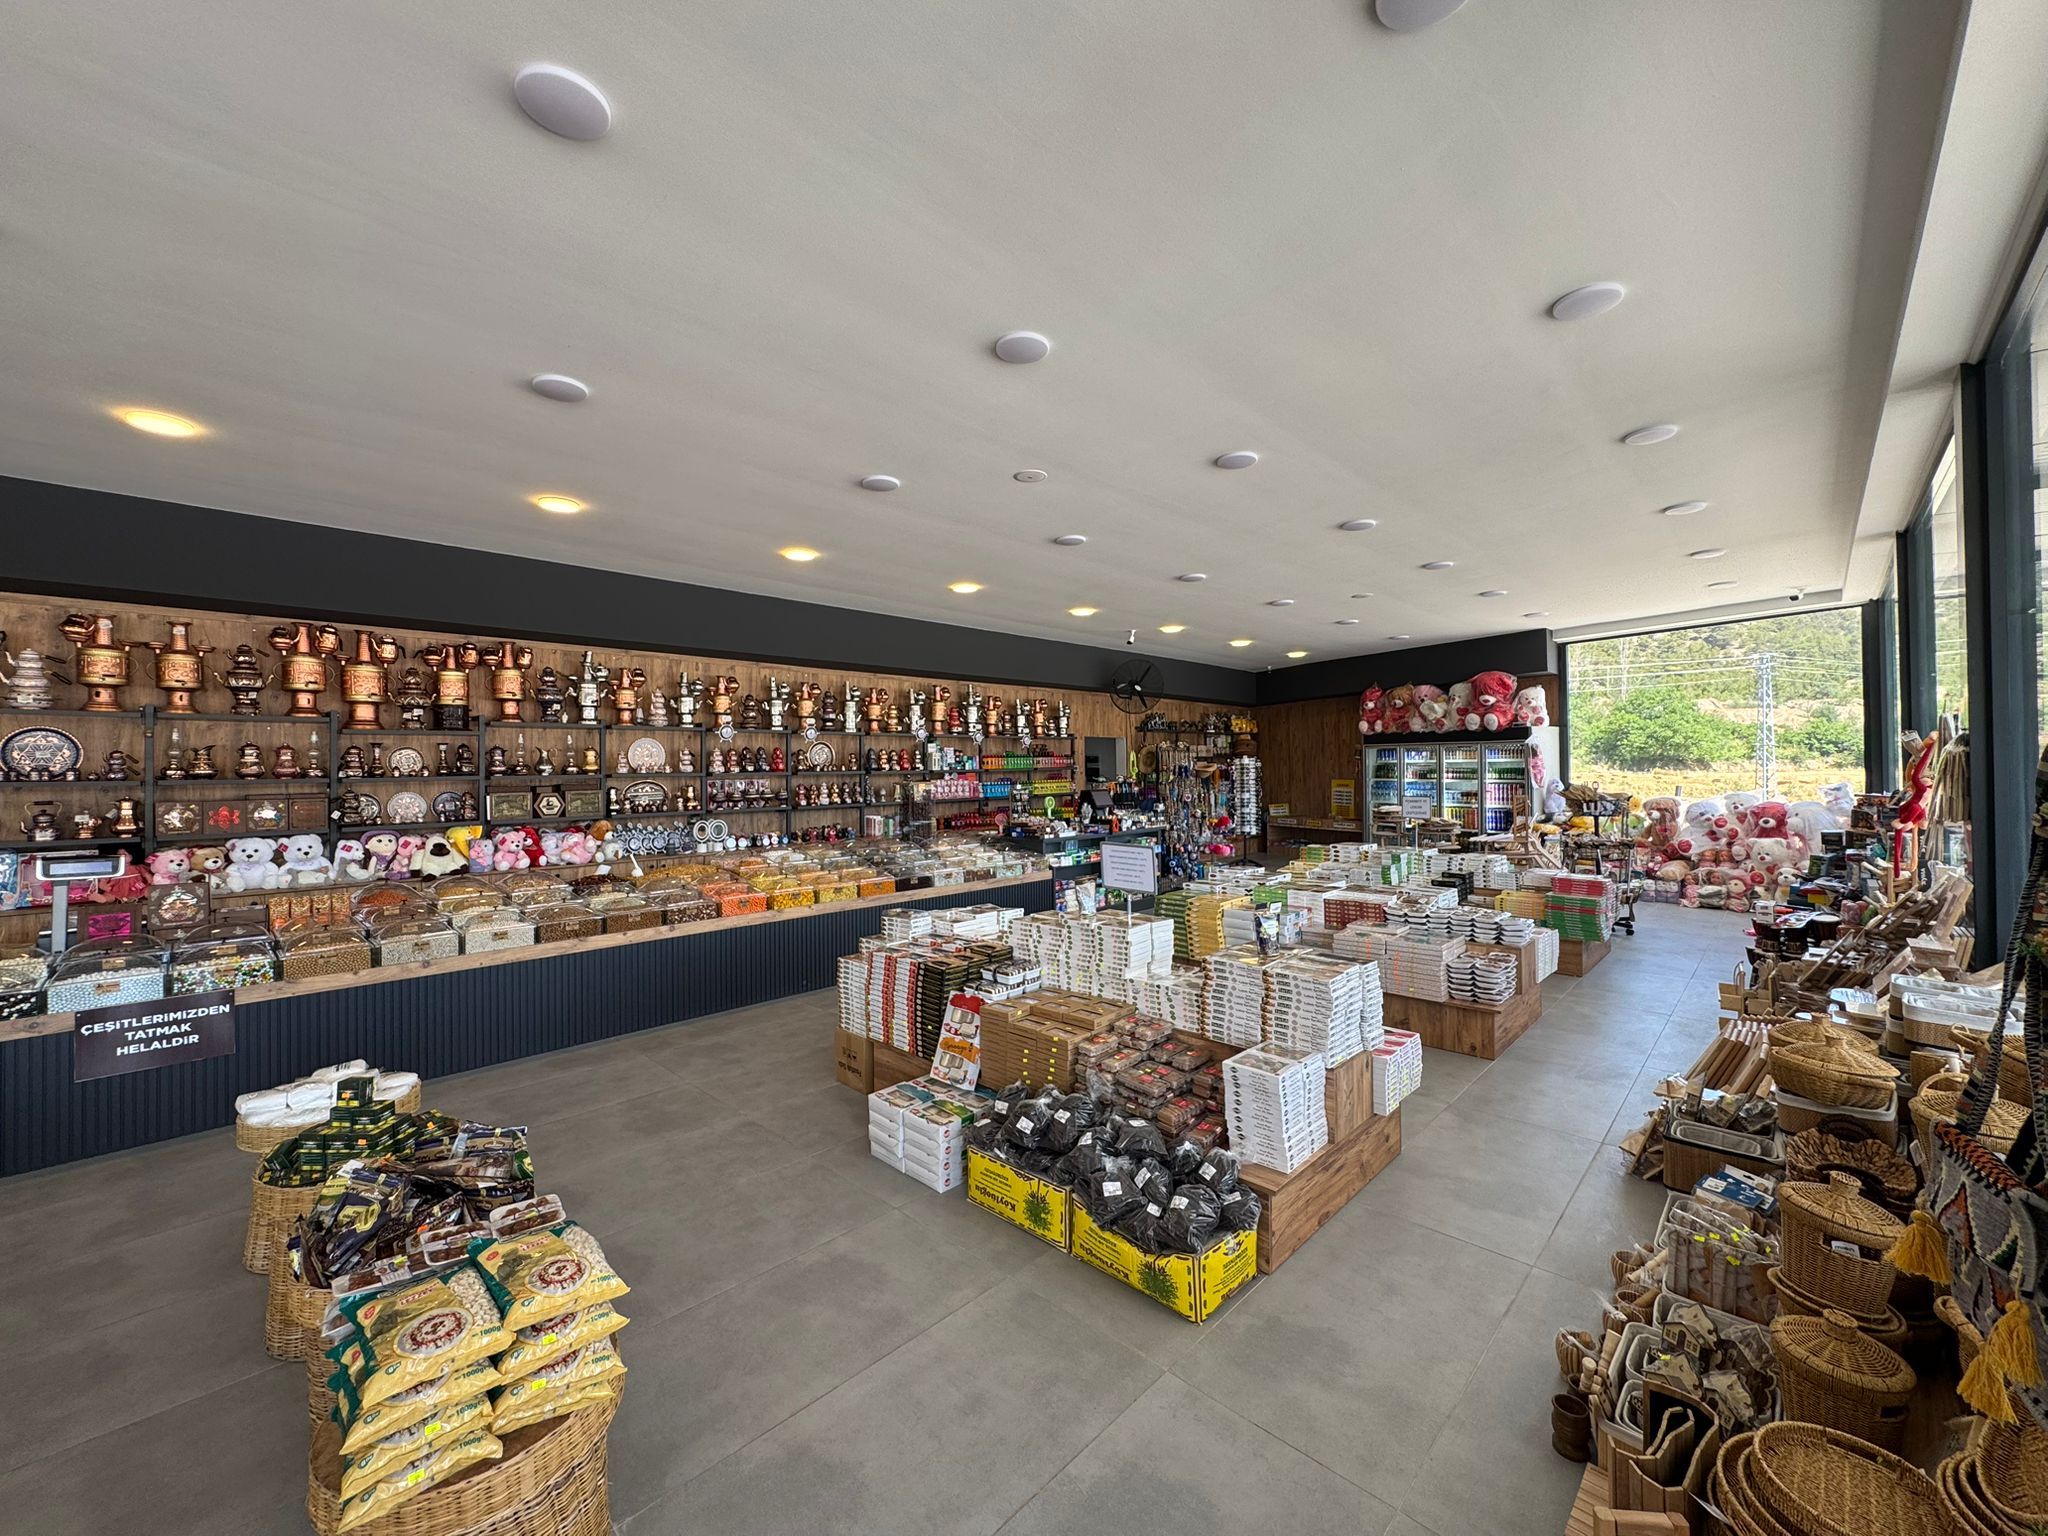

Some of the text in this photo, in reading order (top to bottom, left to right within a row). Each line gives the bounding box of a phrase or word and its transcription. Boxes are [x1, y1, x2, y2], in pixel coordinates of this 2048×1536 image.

[80, 1003, 231, 1037] ÇEŞİTLERİMİZDEN
[124, 1022, 193, 1041] TATMAK
[116, 1034, 200, 1057] HELALDİR
